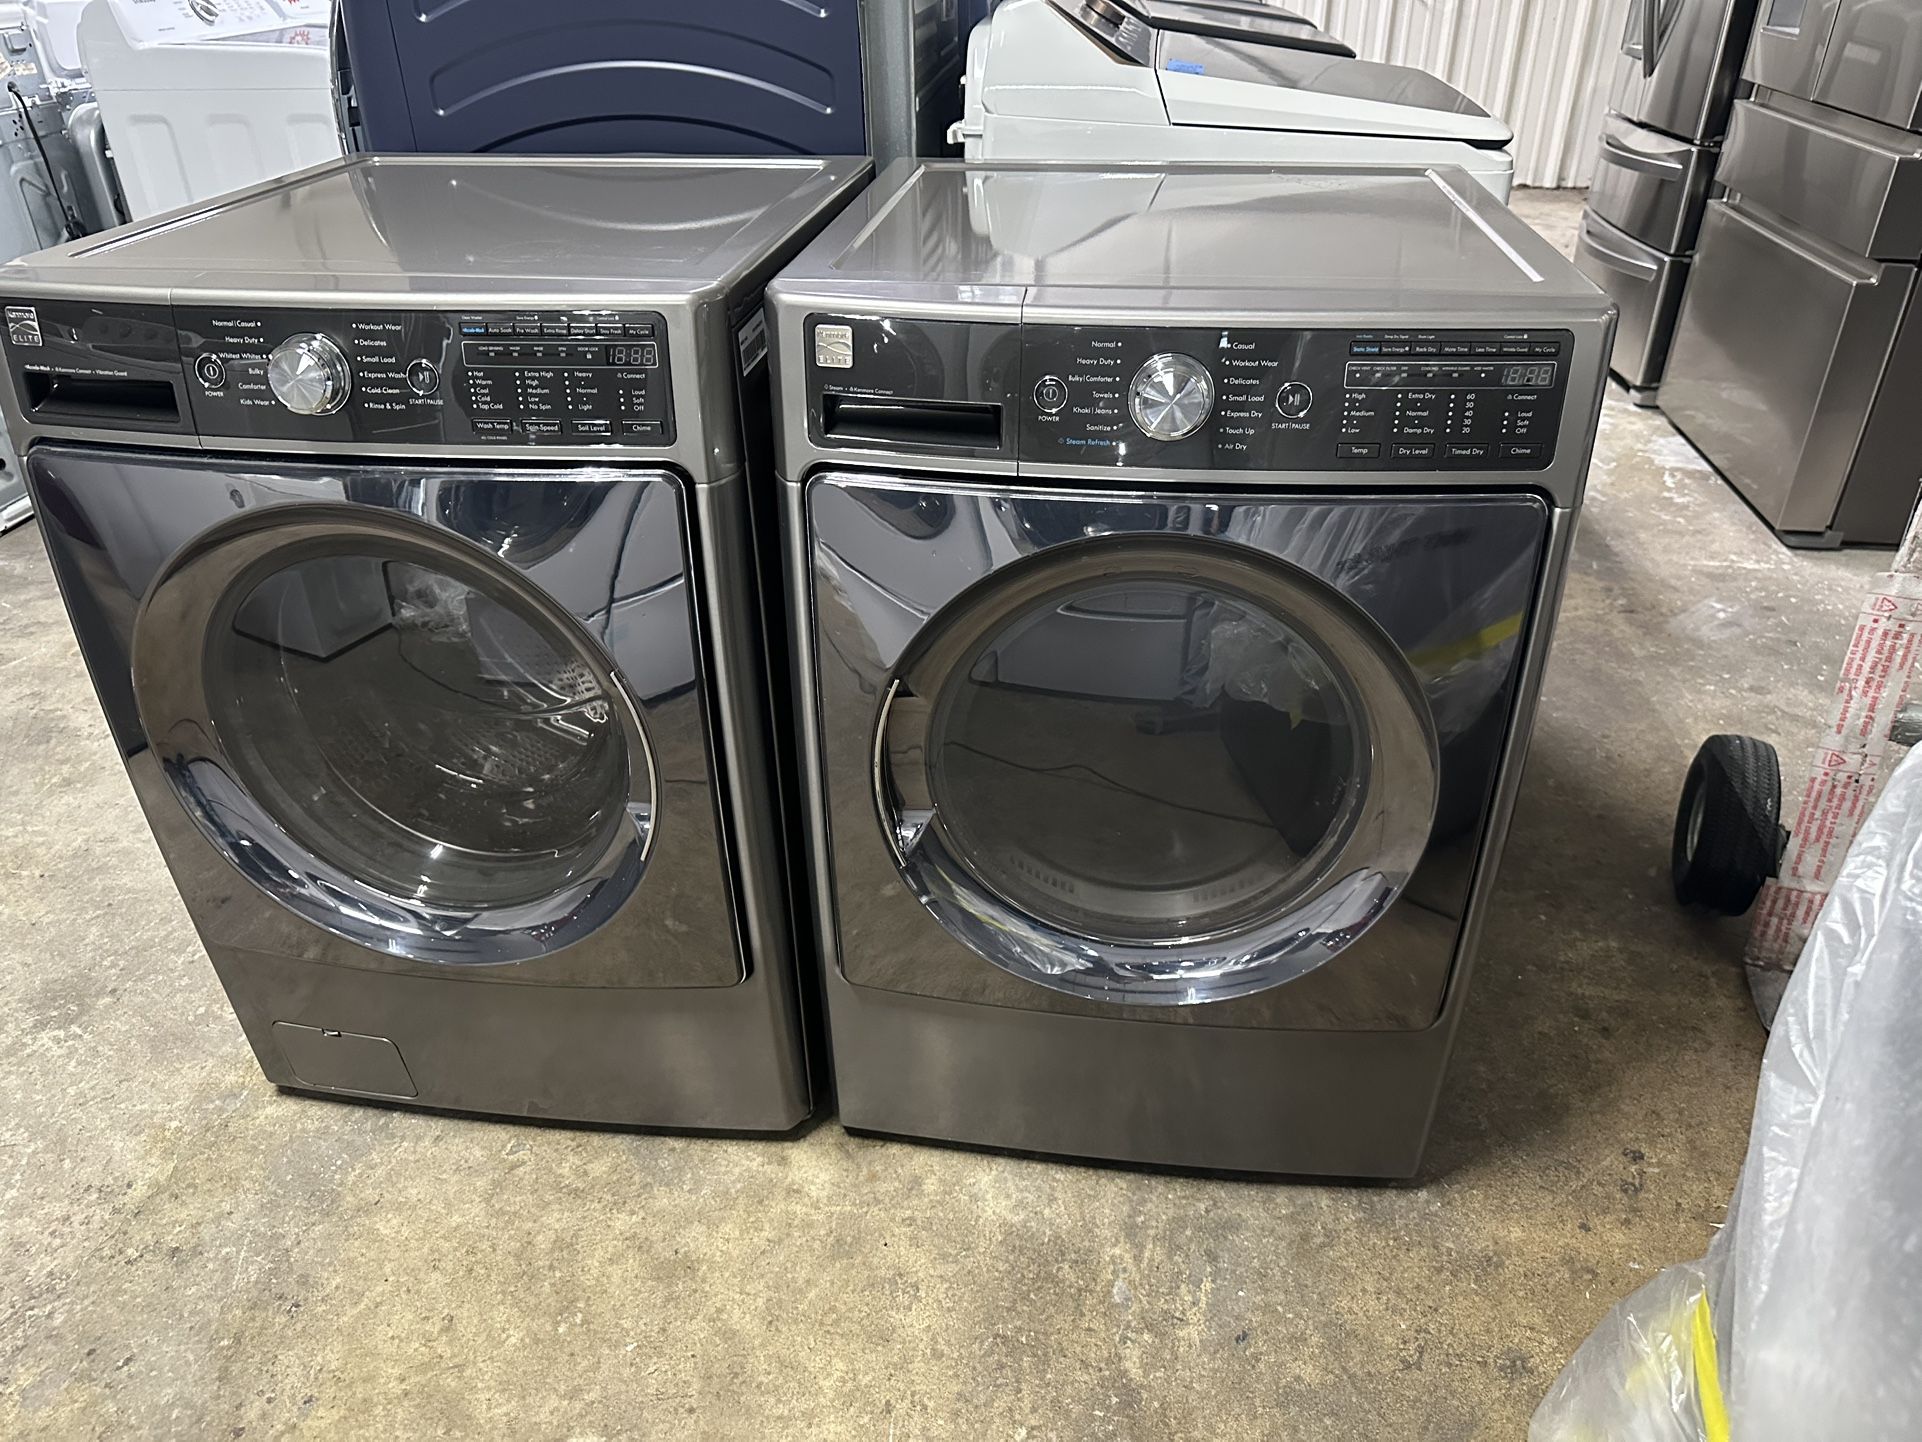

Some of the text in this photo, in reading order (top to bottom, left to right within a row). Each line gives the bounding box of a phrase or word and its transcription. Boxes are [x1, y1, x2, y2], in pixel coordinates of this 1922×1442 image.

[13, 334, 39, 342] ELITE
[225, 337, 258, 345] Heavy Duty
[818, 355, 850, 364] ELITE
[1076, 358, 1114, 366] Heavy Duty
[248, 368, 264, 376] Bulky
[364, 371, 386, 379] Express
[1229, 377, 1260, 385] Delicates
[1248, 394, 1265, 402] Load
[1226, 410, 1263, 418] Express Dry
[1244, 427, 1255, 435] Up
[1087, 438, 1110, 446] Refresh
[1235, 443, 1247, 451] Dry
[1351, 446, 1368, 455] Temp
[1398, 447, 1410, 455] Dry
[1867, 625, 1877, 636] No
[1858, 636, 1872, 662] remover
[1884, 641, 1897, 664] retirez
[1853, 663, 1864, 677] esta
[1874, 680, 1884, 694] ceci
[1867, 695, 1879, 713] avant
